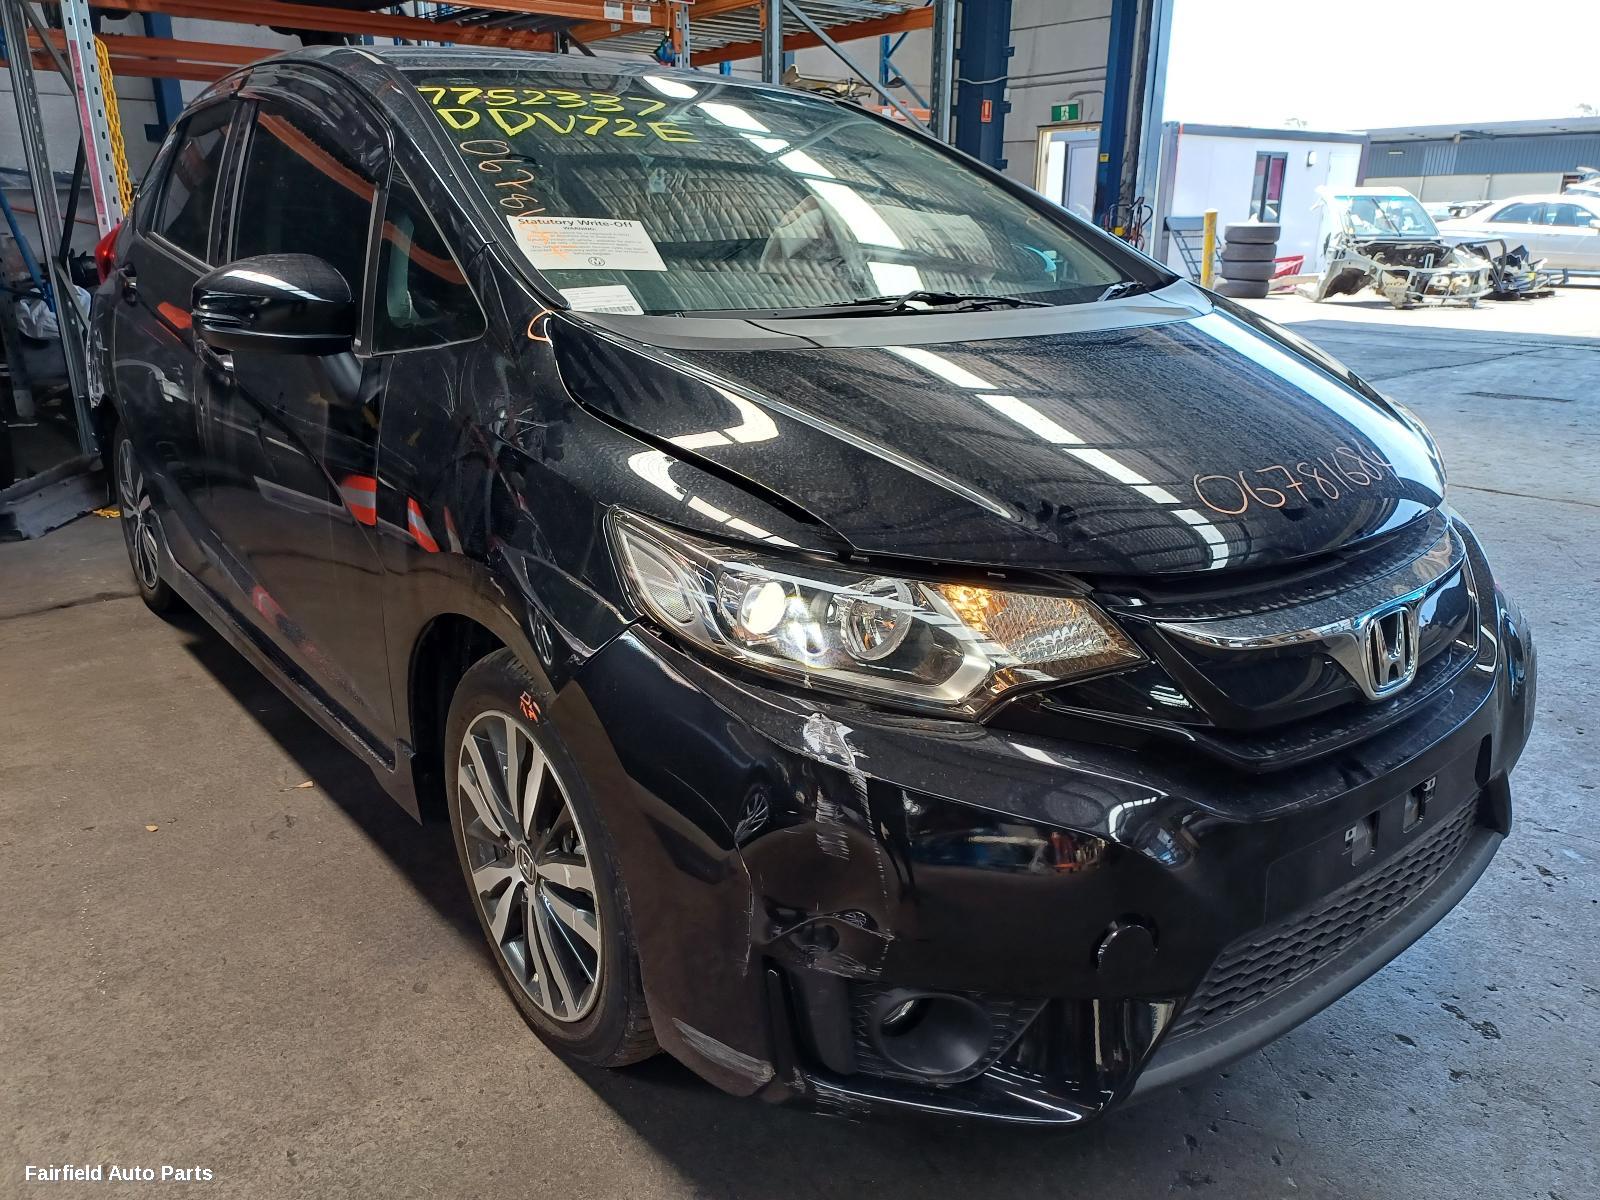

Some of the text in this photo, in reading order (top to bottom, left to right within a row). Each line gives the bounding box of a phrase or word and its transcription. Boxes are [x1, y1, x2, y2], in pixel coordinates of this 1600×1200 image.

[417, 86, 666, 116] 7752337
[518, 218, 633, 229] Statutory Write-Off
